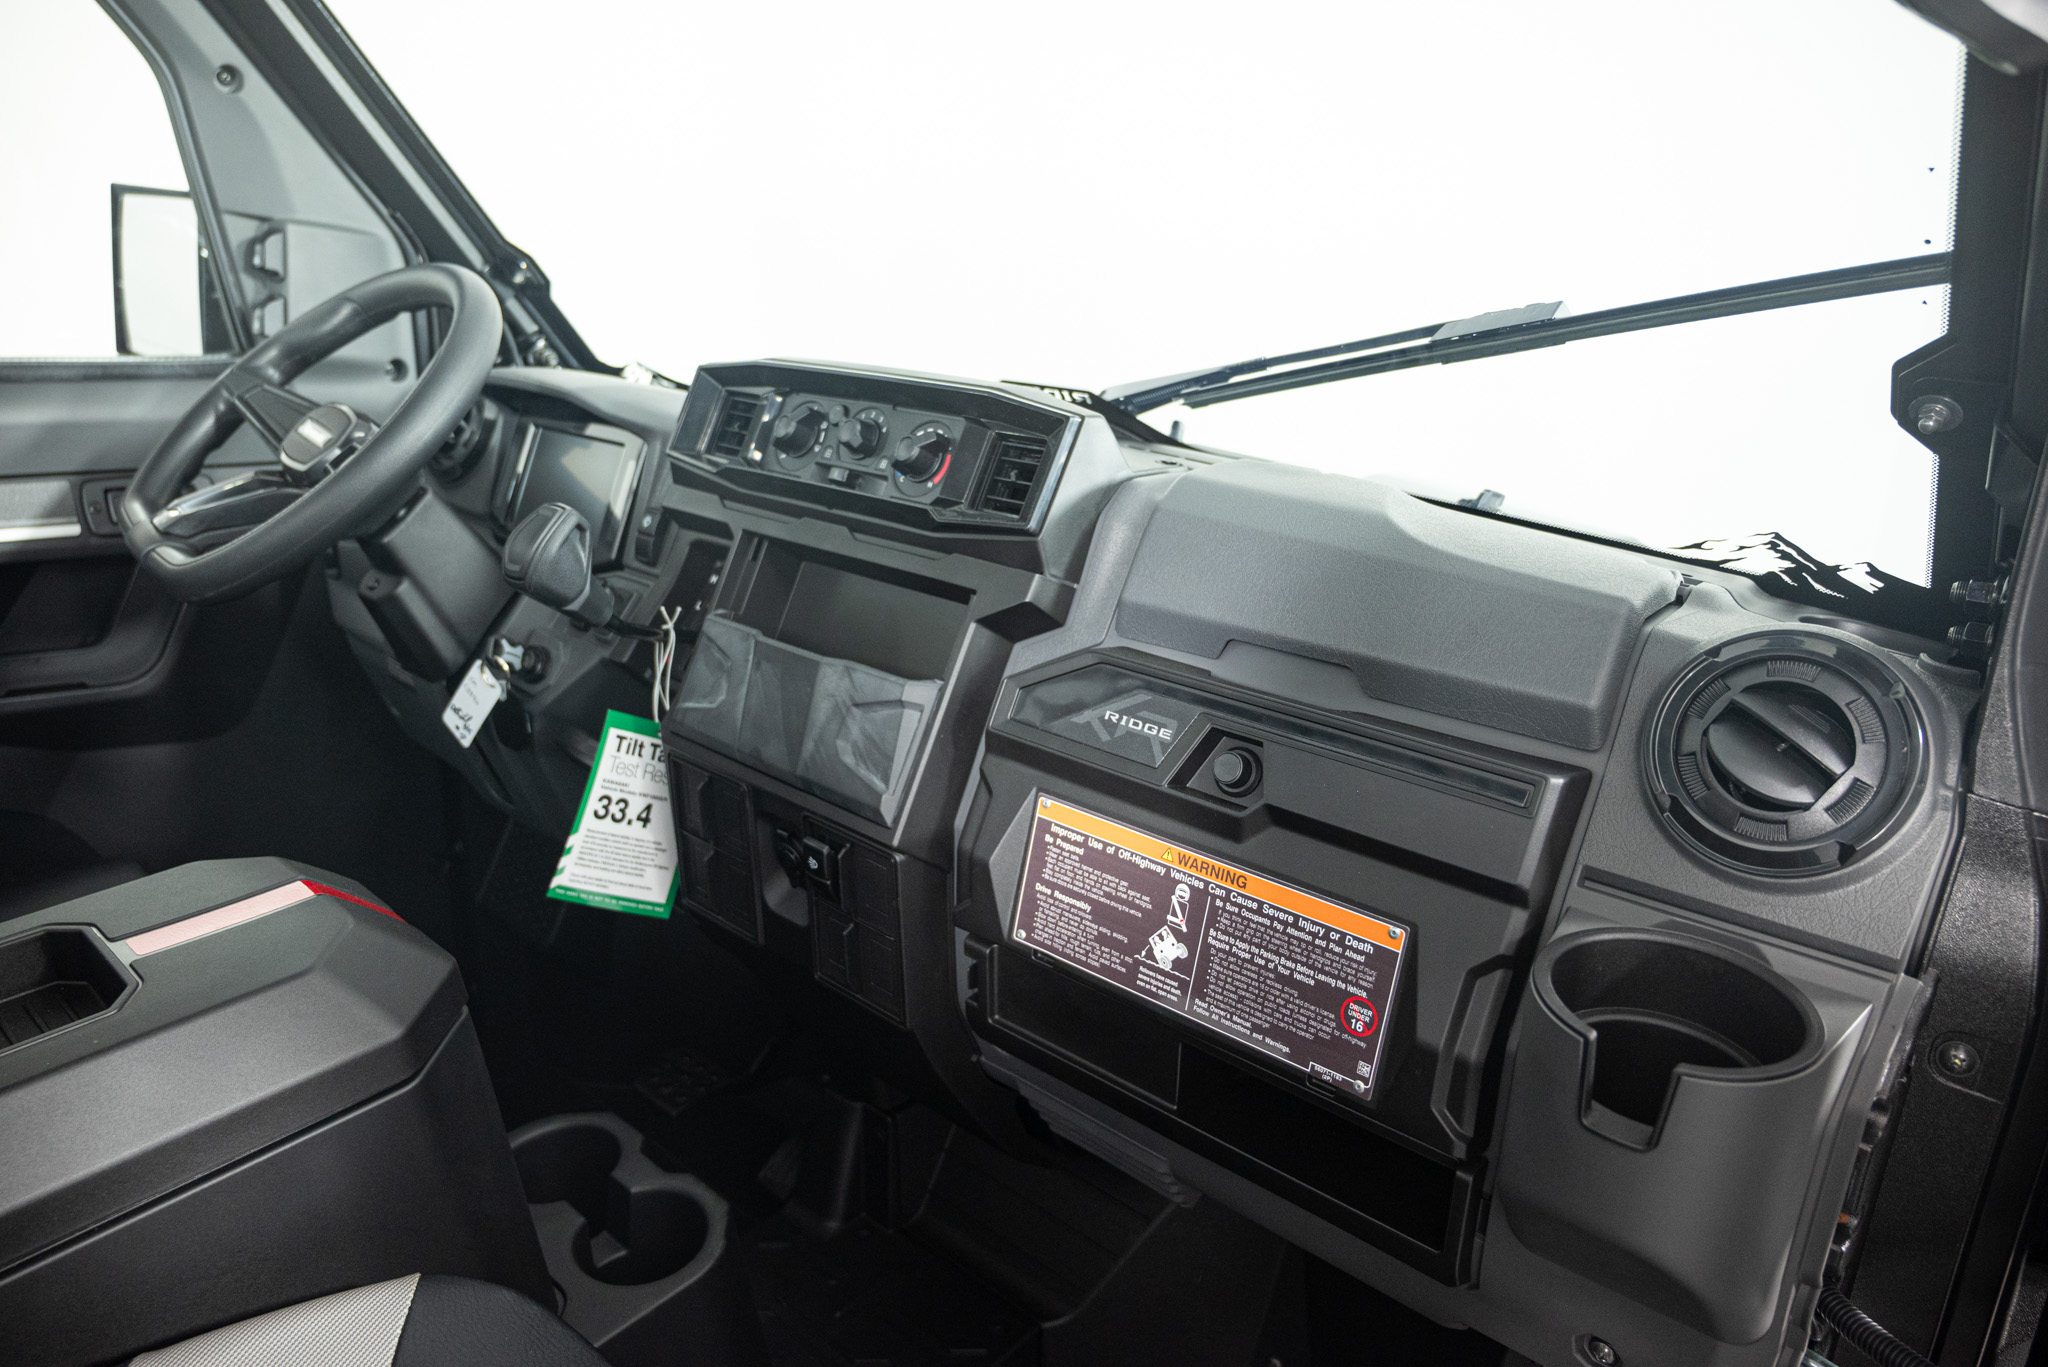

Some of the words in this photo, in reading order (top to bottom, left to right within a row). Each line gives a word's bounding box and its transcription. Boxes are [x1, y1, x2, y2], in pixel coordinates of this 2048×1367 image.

[1103, 709, 1174, 742] RIDGE
[616, 735, 646, 758] Tilt
[609, 754, 639, 779] Test
[593, 794, 654, 829] 33.4
[1044, 834, 1053, 843] Be
[1055, 838, 1084, 855] Prepared
[1178, 852, 1247, 888] WARNING
[1035, 882, 1051, 894] Drive
[1053, 890, 1091, 912] Responsibly
[1050, 823, 1084, 842] Improper
[1087, 837, 1103, 850] Use
[1105, 845, 1115, 854] of
[1118, 849, 1166, 875] Off-Highway
[1170, 868, 1204, 888] Vehicles
[1208, 883, 1225, 897] Can
[1230, 892, 1257, 909] Cause
[1262, 904, 1293, 922] Severe
[1298, 917, 1324, 936] Injury
[1329, 931, 1339, 940] or
[1345, 935, 1373, 953] Death
[1215, 898, 1223, 907] Be
[1225, 902, 1238, 913] Sure
[1240, 908, 1270, 925] Occupants
[1272, 920, 1284, 932] Pay
[1286, 926, 1312, 941] Attention
[1314, 938, 1326, 947] and
[1328, 942, 1342, 953] Plan
[1344, 948, 1365, 962] Ahead
[1207, 936, 1229, 950] Require
[1231, 946, 1251, 959] Proper
[1253, 954, 1265, 965] Use
[1277, 964, 1290, 975] Your
[1293, 971, 1314, 985] Vehicle
[1208, 928, 1216, 936] Be
[1216, 931, 1228, 942] Sure
[1234, 939, 1250, 951] Apply
[1250, 945, 1259, 954] the
[1259, 948, 1279, 964] Parking
[1279, 956, 1295, 968] Brake
[1296, 963, 1314, 976] Before
[1314, 970, 1336, 987] Leaving
[1336, 979, 1345, 989] the
[1346, 983, 1367, 998] Vehicle.
[1243, 962, 1258, 972] prevent
[1278, 947, 1290, 956] body
[1291, 952, 1306, 962] outside
[1323, 966, 1338, 974] vehicle
[1347, 975, 1356, 983] any
[1241, 968, 1257, 979] careless
[1265, 979, 1282, 989] reckless
[1194, 998, 1208, 1008] Read
[1209, 1004, 1230, 1018] Owner's
[1232, 1014, 1251, 1028] Manual.
[1232, 979, 1247, 989] people
[1248, 986, 1258, 994] drive
[1286, 1003, 1298, 1012] using
[1299, 1008, 1315, 1017] alcohol
[1349, 1002, 1372, 1016] DRIVER
[1192, 1005, 1209, 1016] Follow
[1220, 1017, 1250, 1034] Instructions
[1252, 1032, 1262, 1040] and
[1264, 1036, 1290, 1052] Warnings.
[1347, 1009, 1369, 1022] UNDER
[1350, 1018, 1363, 1032] 16
